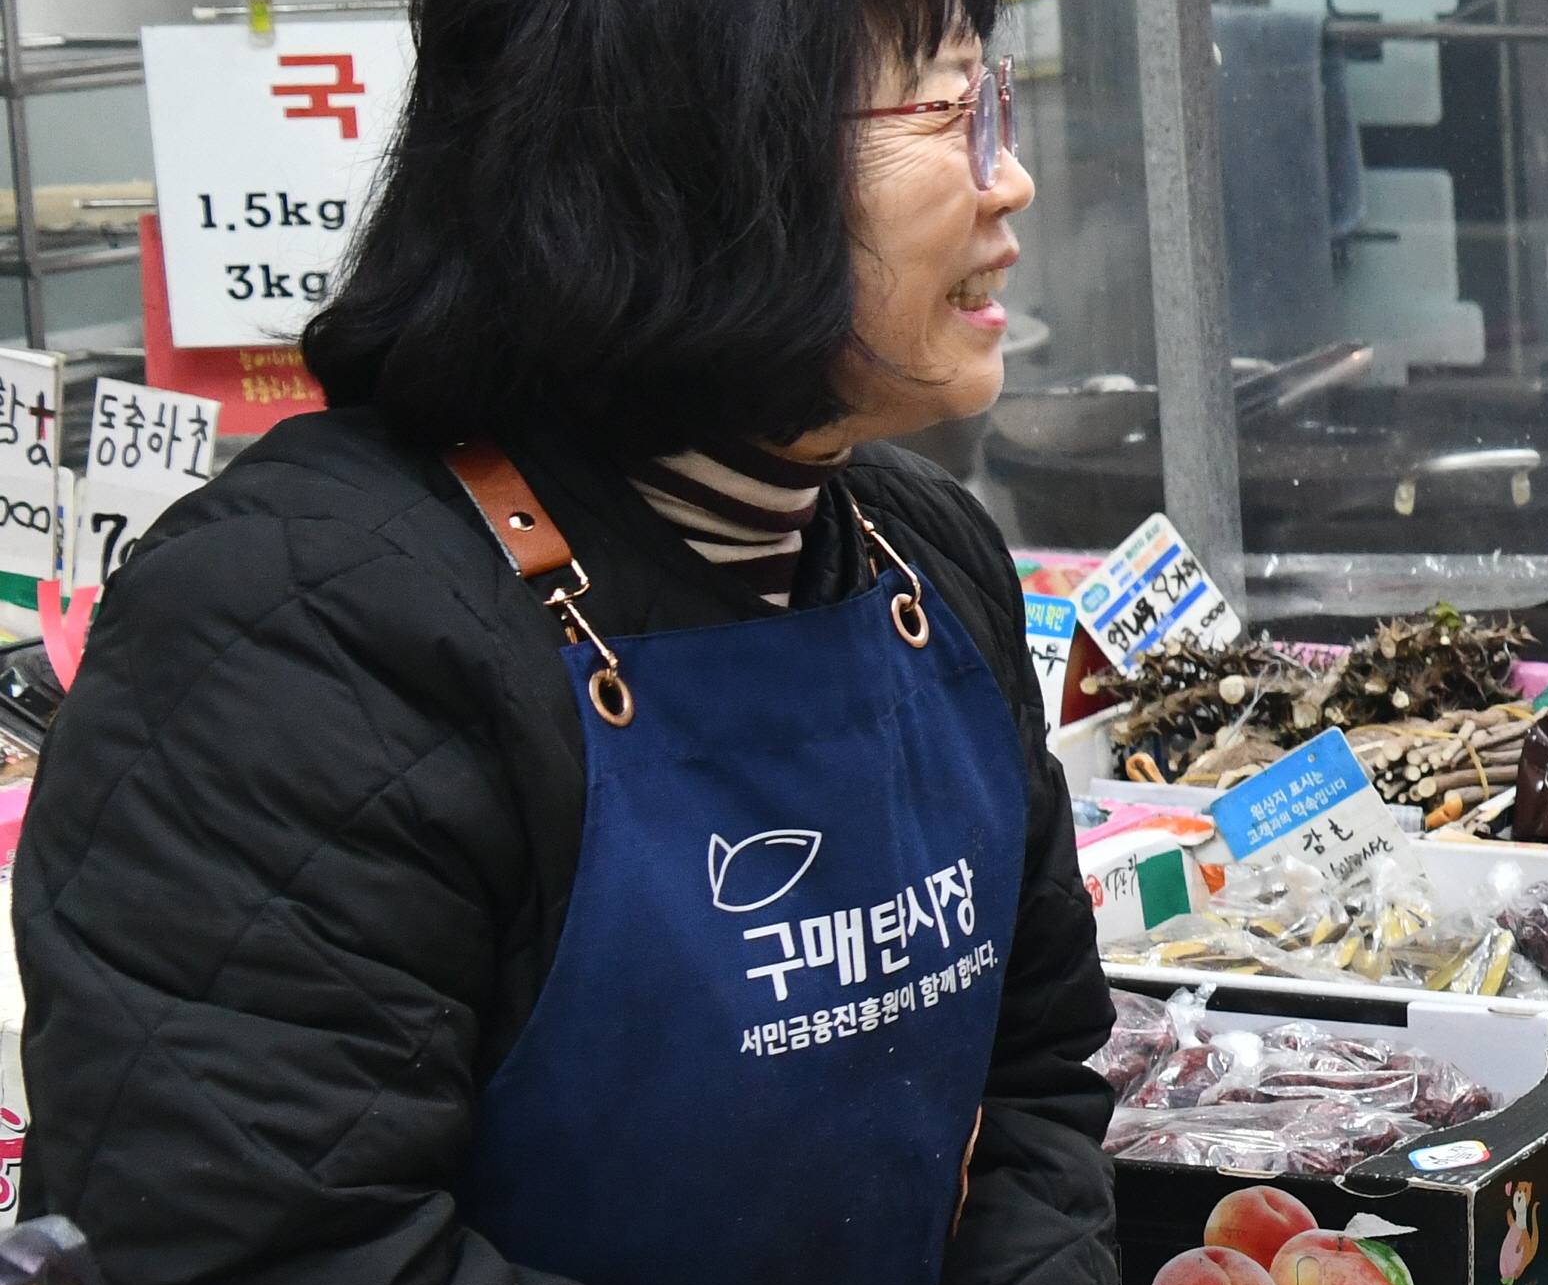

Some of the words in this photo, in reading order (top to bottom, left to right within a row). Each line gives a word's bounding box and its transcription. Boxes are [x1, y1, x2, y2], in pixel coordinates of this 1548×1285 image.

[270, 54, 365, 139] 국
[199, 192, 348, 231] 1.5kg
[226, 263, 330, 304] 3kg
[93, 394, 212, 480] 동충하초
[1249, 791, 1288, 821] 원산지
[743, 858, 974, 1002] 구매탄시장
[740, 981, 916, 1057] 서민금융진흥원이
[918, 966, 956, 1009] 함께
[957, 939, 999, 988] 합니다.
